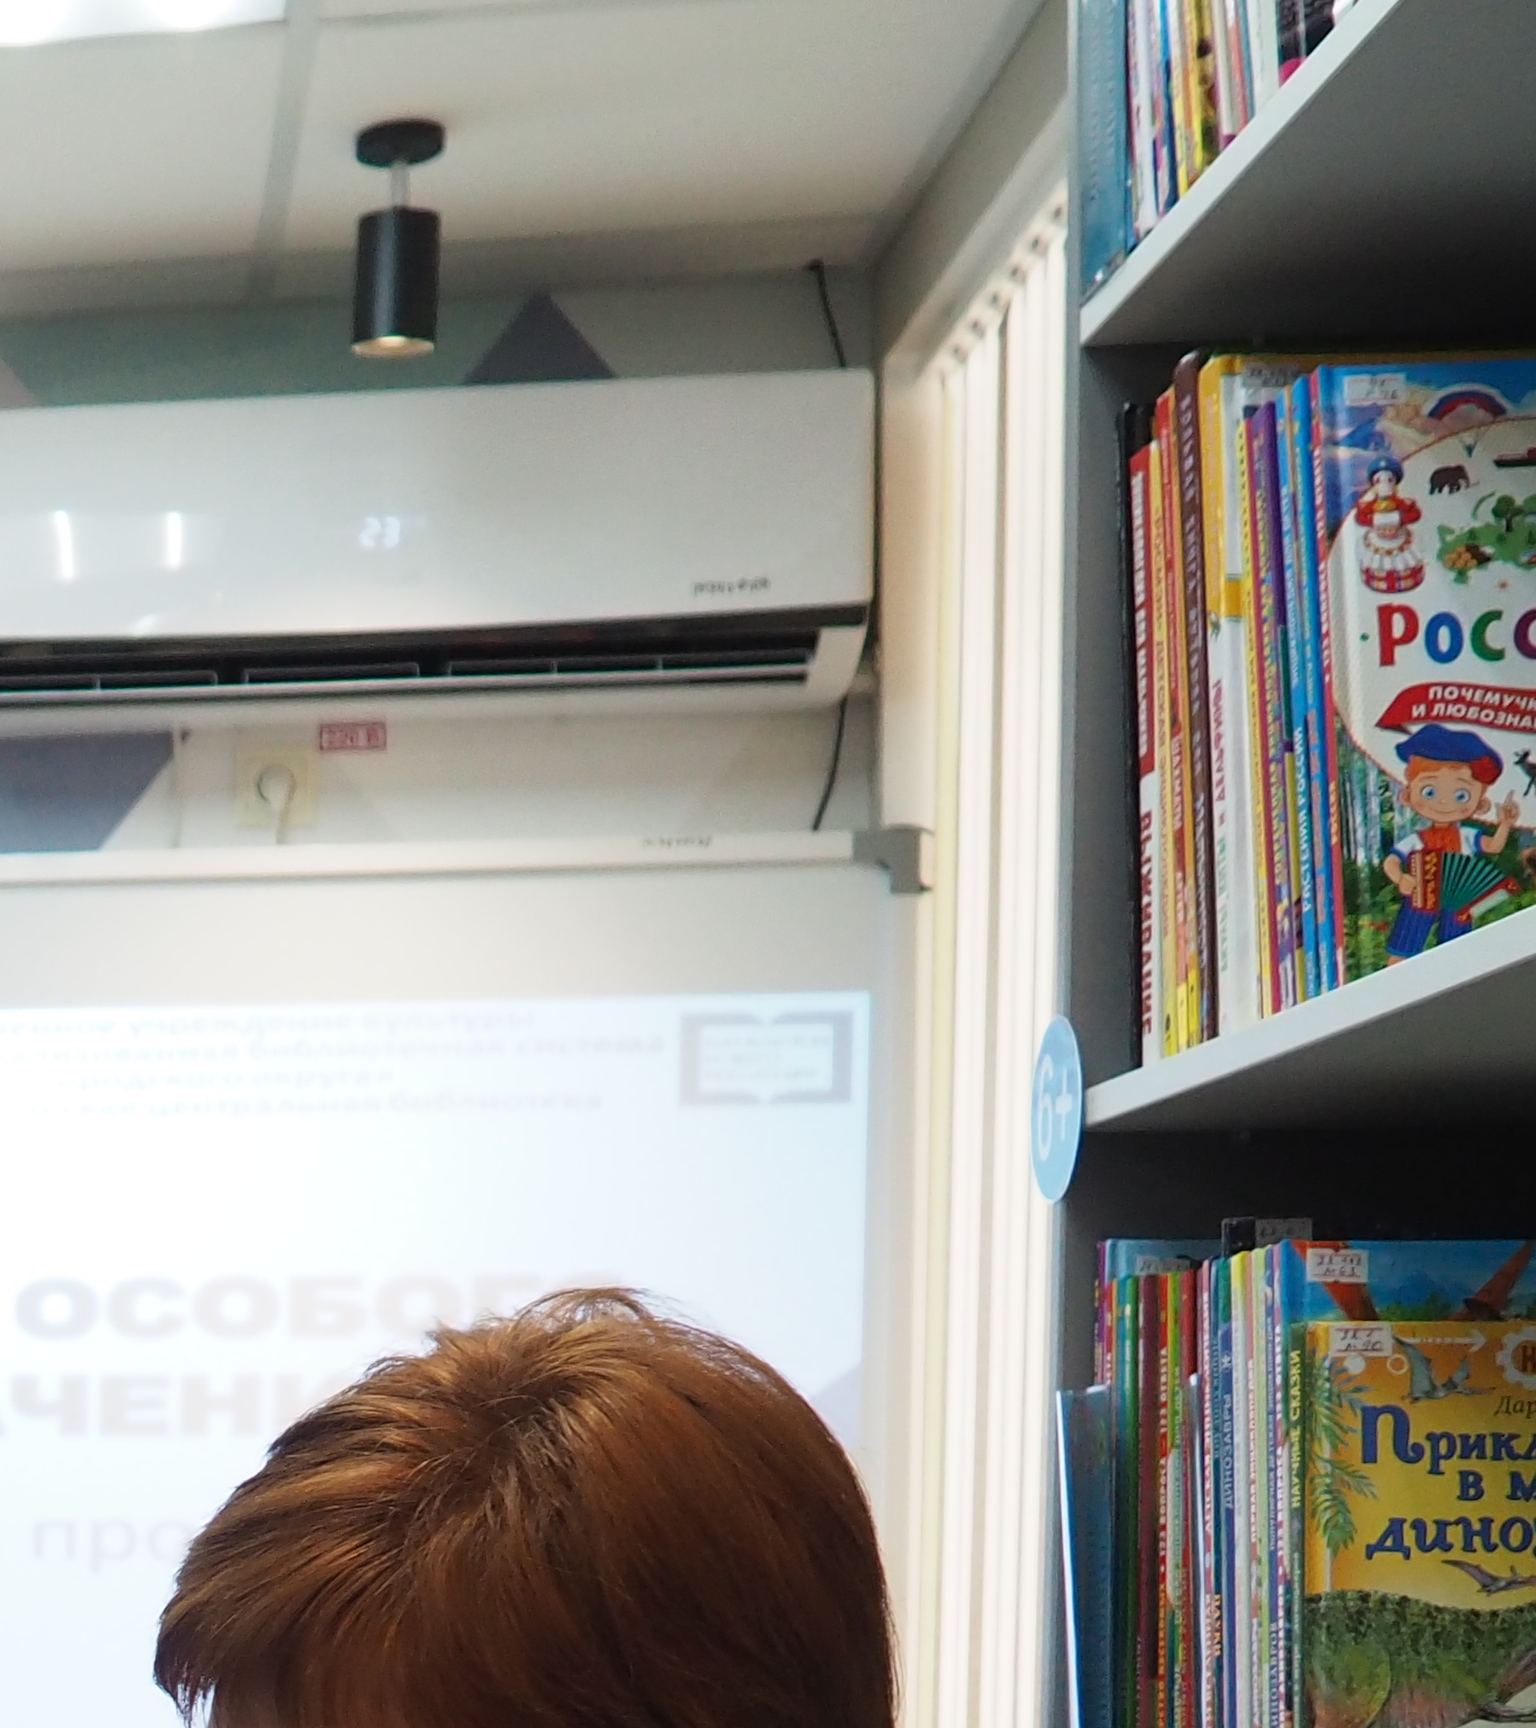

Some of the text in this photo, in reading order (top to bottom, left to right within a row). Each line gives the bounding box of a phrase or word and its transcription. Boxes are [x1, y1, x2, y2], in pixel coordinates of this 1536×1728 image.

[1139, 810, 1154, 1036] ВЫЖИВАНИЕ
[1036, 1053, 1074, 1164] 6+
[11, 1273, 626, 1342] ОСОБОГ
[29, 1516, 204, 1576] про
[1365, 1515, 1536, 1561] дино
